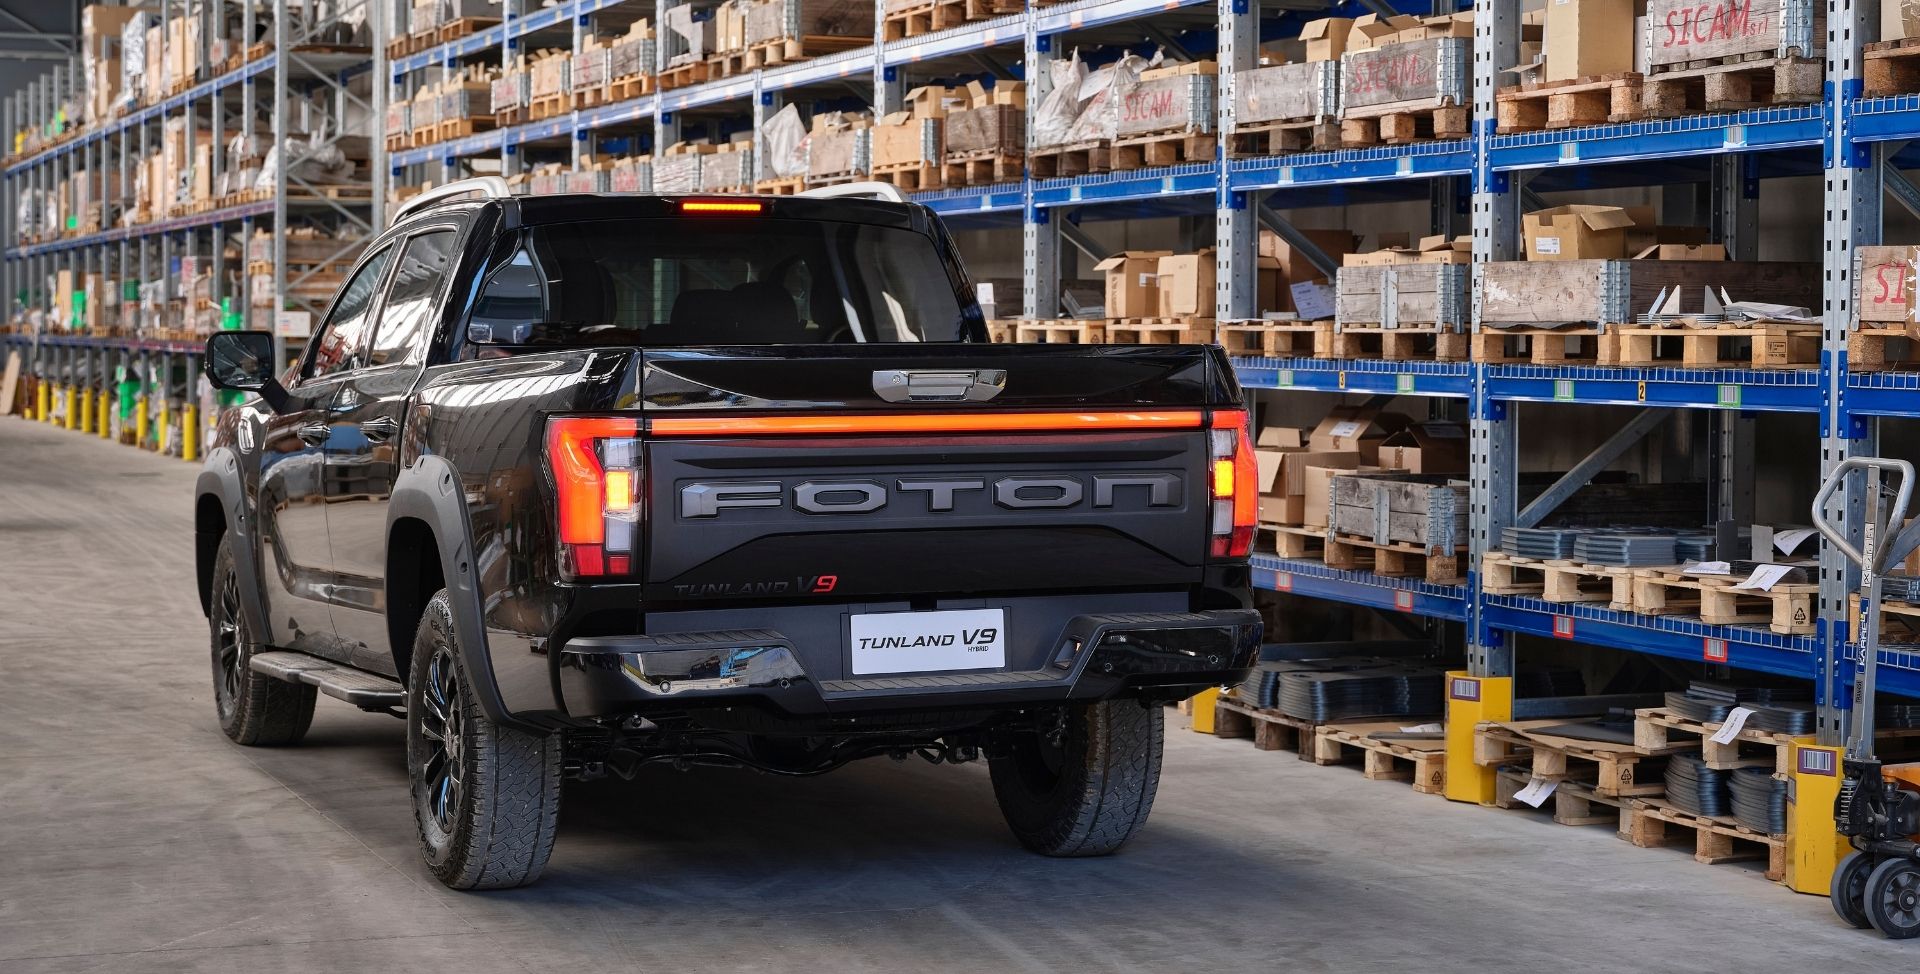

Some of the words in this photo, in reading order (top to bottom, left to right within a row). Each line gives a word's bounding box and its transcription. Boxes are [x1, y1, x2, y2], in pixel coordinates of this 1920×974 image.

[1663, 0, 1751, 48] SICAM
[1351, 53, 1418, 94] SICAM
[1123, 88, 1173, 121] SICAM
[1639, 384, 1645, 400] 2
[680, 473, 1182, 520] FOTON
[672, 580, 790, 596] TUNLAND
[796, 574, 839, 593] V9
[859, 634, 955, 650] TUNLAND
[962, 628, 998, 646] V9
[967, 645, 990, 653] HYBRID
